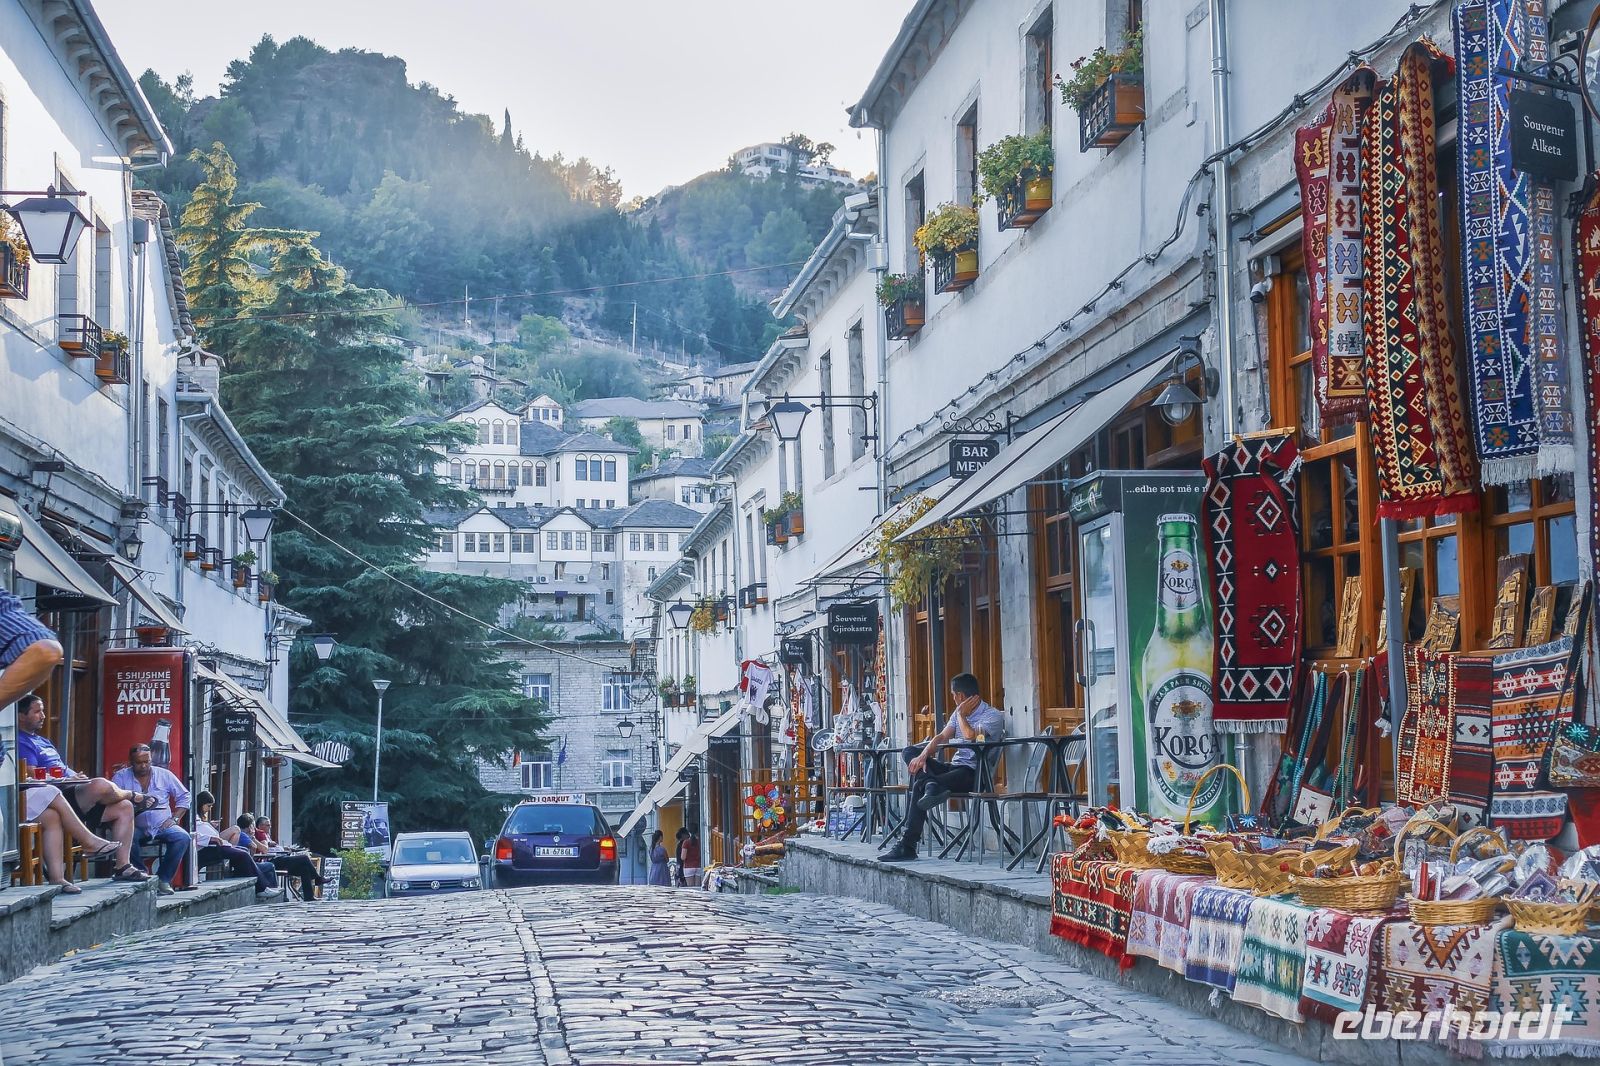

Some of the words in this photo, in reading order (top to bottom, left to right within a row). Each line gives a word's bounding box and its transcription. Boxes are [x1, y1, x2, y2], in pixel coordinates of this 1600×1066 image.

[1523, 115, 1565, 137] Souvenir
[1531, 137, 1562, 156] Alketa
[962, 446, 989, 457] BAR
[956, 461, 988, 472] MEN
[1160, 485, 1175, 493] sot
[1176, 484, 1192, 493] më
[835, 614, 868, 623] Souvenir
[832, 624, 873, 634] Gjirokastra
[117, 672, 123, 680] E
[117, 689, 171, 703] AKULL
[117, 704, 124, 715] E
[127, 701, 171, 715] FTOHTË
[314, 741, 351, 763] ANTIQUE
